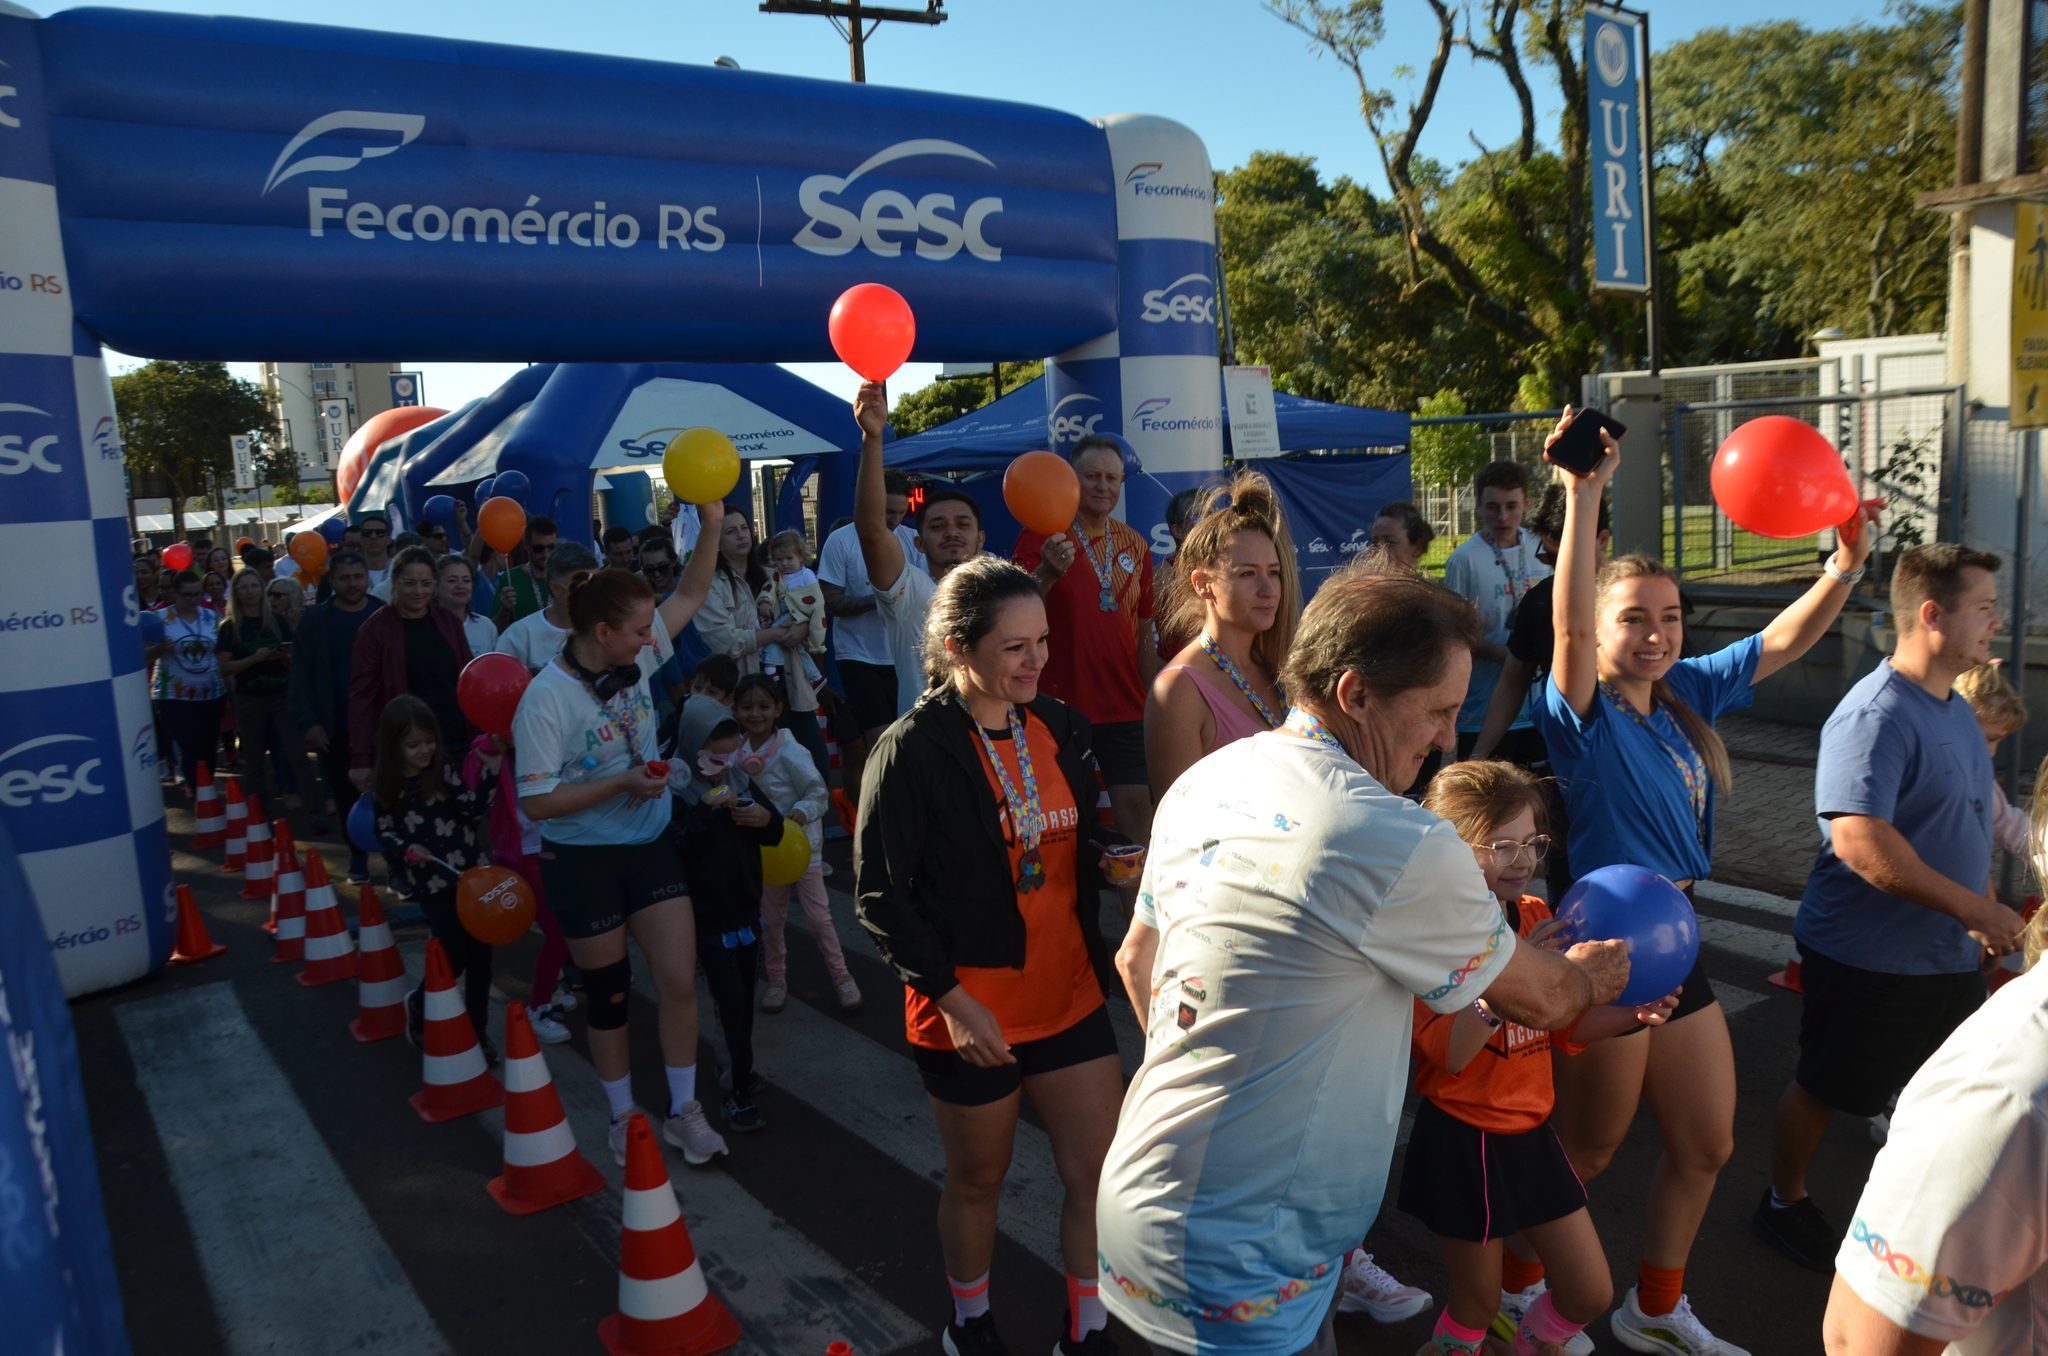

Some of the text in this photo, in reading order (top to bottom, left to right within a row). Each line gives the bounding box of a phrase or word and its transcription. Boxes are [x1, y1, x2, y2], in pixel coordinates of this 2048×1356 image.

[1134, 182, 1206, 201] Fecomércio
[1600, 99, 1632, 278] URI
[307, 186, 726, 252] Fecomércio RS
[792, 174, 1004, 262] Sesc
[30, 273, 63, 294] RS
[1140, 289, 1214, 324] Sesc
[1142, 416, 1214, 431] Fecomércio
[728, 428, 795, 444] ecomércio
[619, 439, 667, 458] Se
[736, 443, 768, 453] enac
[0, 605, 98, 632] ércio RS
[591, 881, 688, 932] RUN MOR
[115, 914, 142, 936] RS
